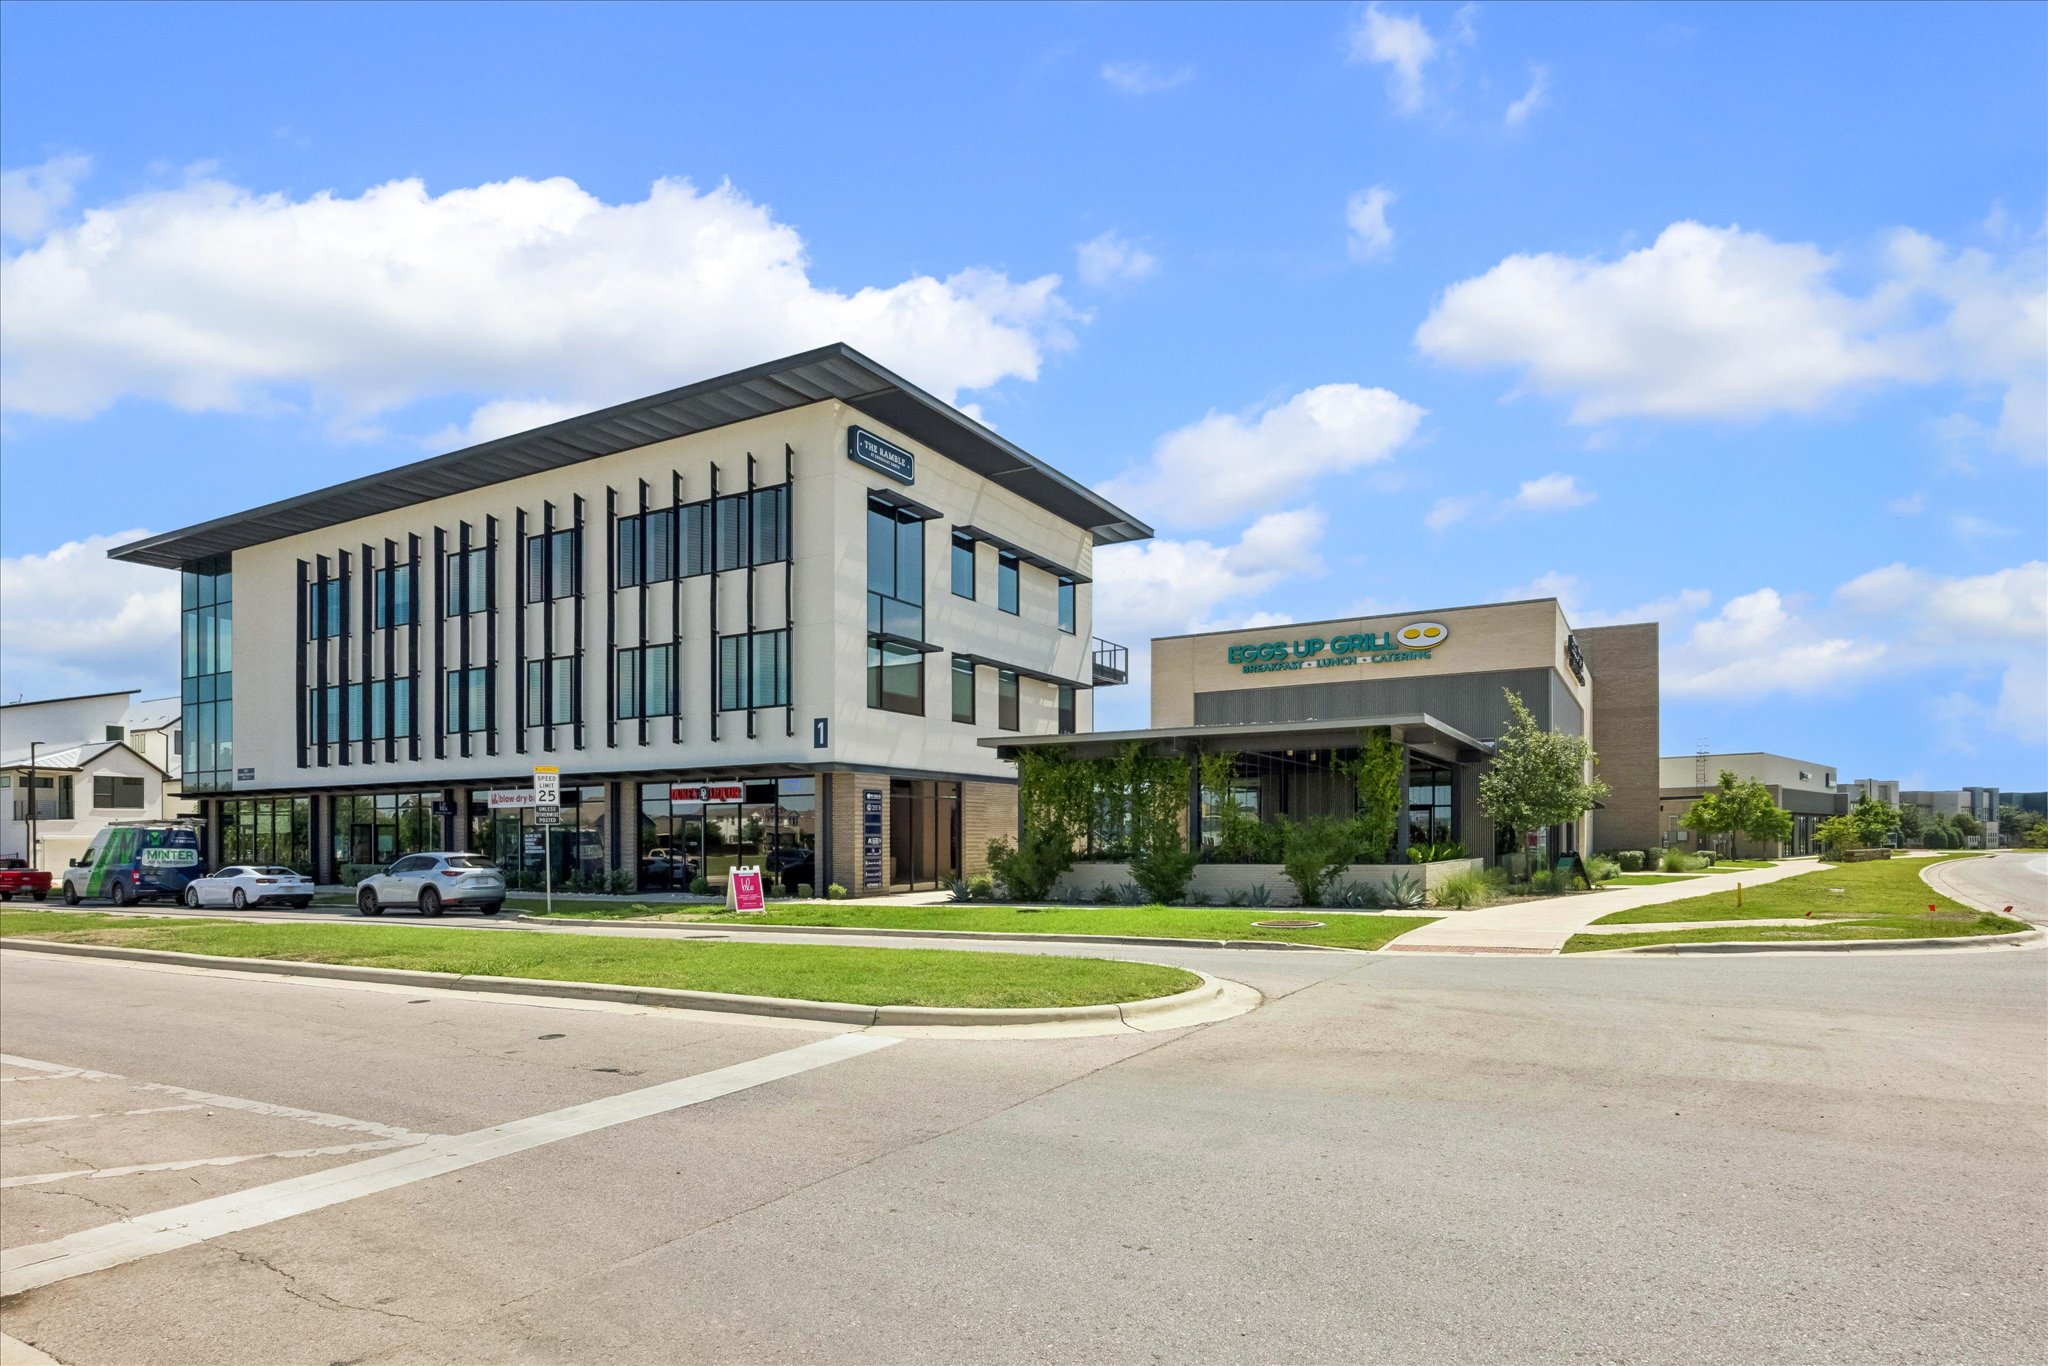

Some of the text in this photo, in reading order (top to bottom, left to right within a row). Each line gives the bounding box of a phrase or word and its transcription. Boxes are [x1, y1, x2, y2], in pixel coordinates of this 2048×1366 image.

[864, 440, 877, 453] THE
[880, 447, 906, 467] RAMBLE
[1228, 631, 1399, 664] EGGS UP GRILL
[1242, 650, 1432, 674] BREAKFAST LUNCH CATERING
[817, 722, 824, 744] 1
[499, 794, 515, 803] blow
[516, 794, 528, 804] dry
[538, 790, 556, 802] 25
[148, 850, 194, 860] MINTER
